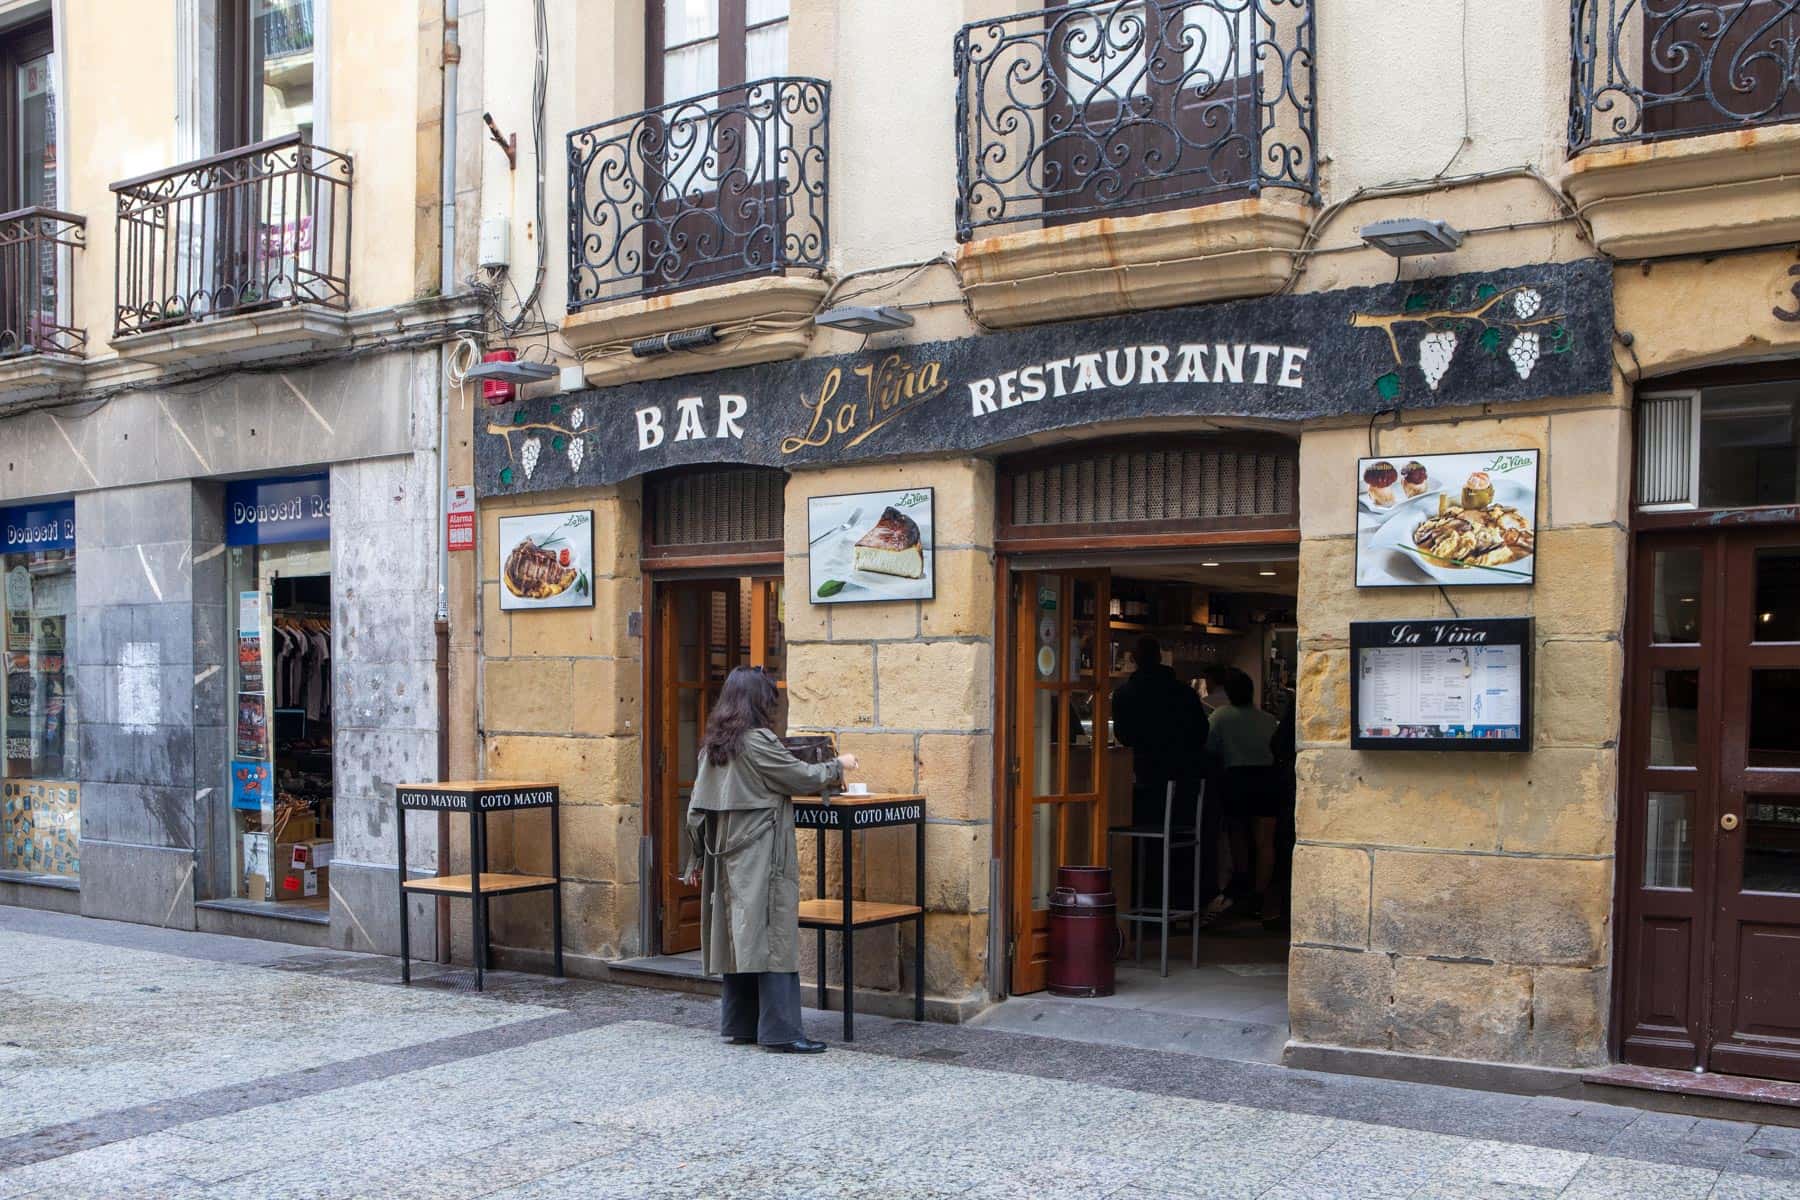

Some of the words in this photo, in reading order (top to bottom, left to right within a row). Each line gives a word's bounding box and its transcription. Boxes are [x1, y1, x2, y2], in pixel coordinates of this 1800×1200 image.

[967, 343, 1311, 417] RESTAURANTE
[781, 367, 858, 455] La
[853, 354, 948, 428] Viña
[635, 394, 748, 451] BAR
[234, 497, 302, 524] Donosti
[7, 520, 58, 545] Donosti
[1390, 624, 1421, 645] La
[1430, 624, 1488, 644] Viña
[401, 792, 428, 806] COTO
[430, 793, 467, 808] MAYOR
[480, 793, 511, 808] COTO
[514, 791, 554, 805] MAYOR
[854, 809, 882, 825] COTO
[884, 805, 920, 821] MAYOR
